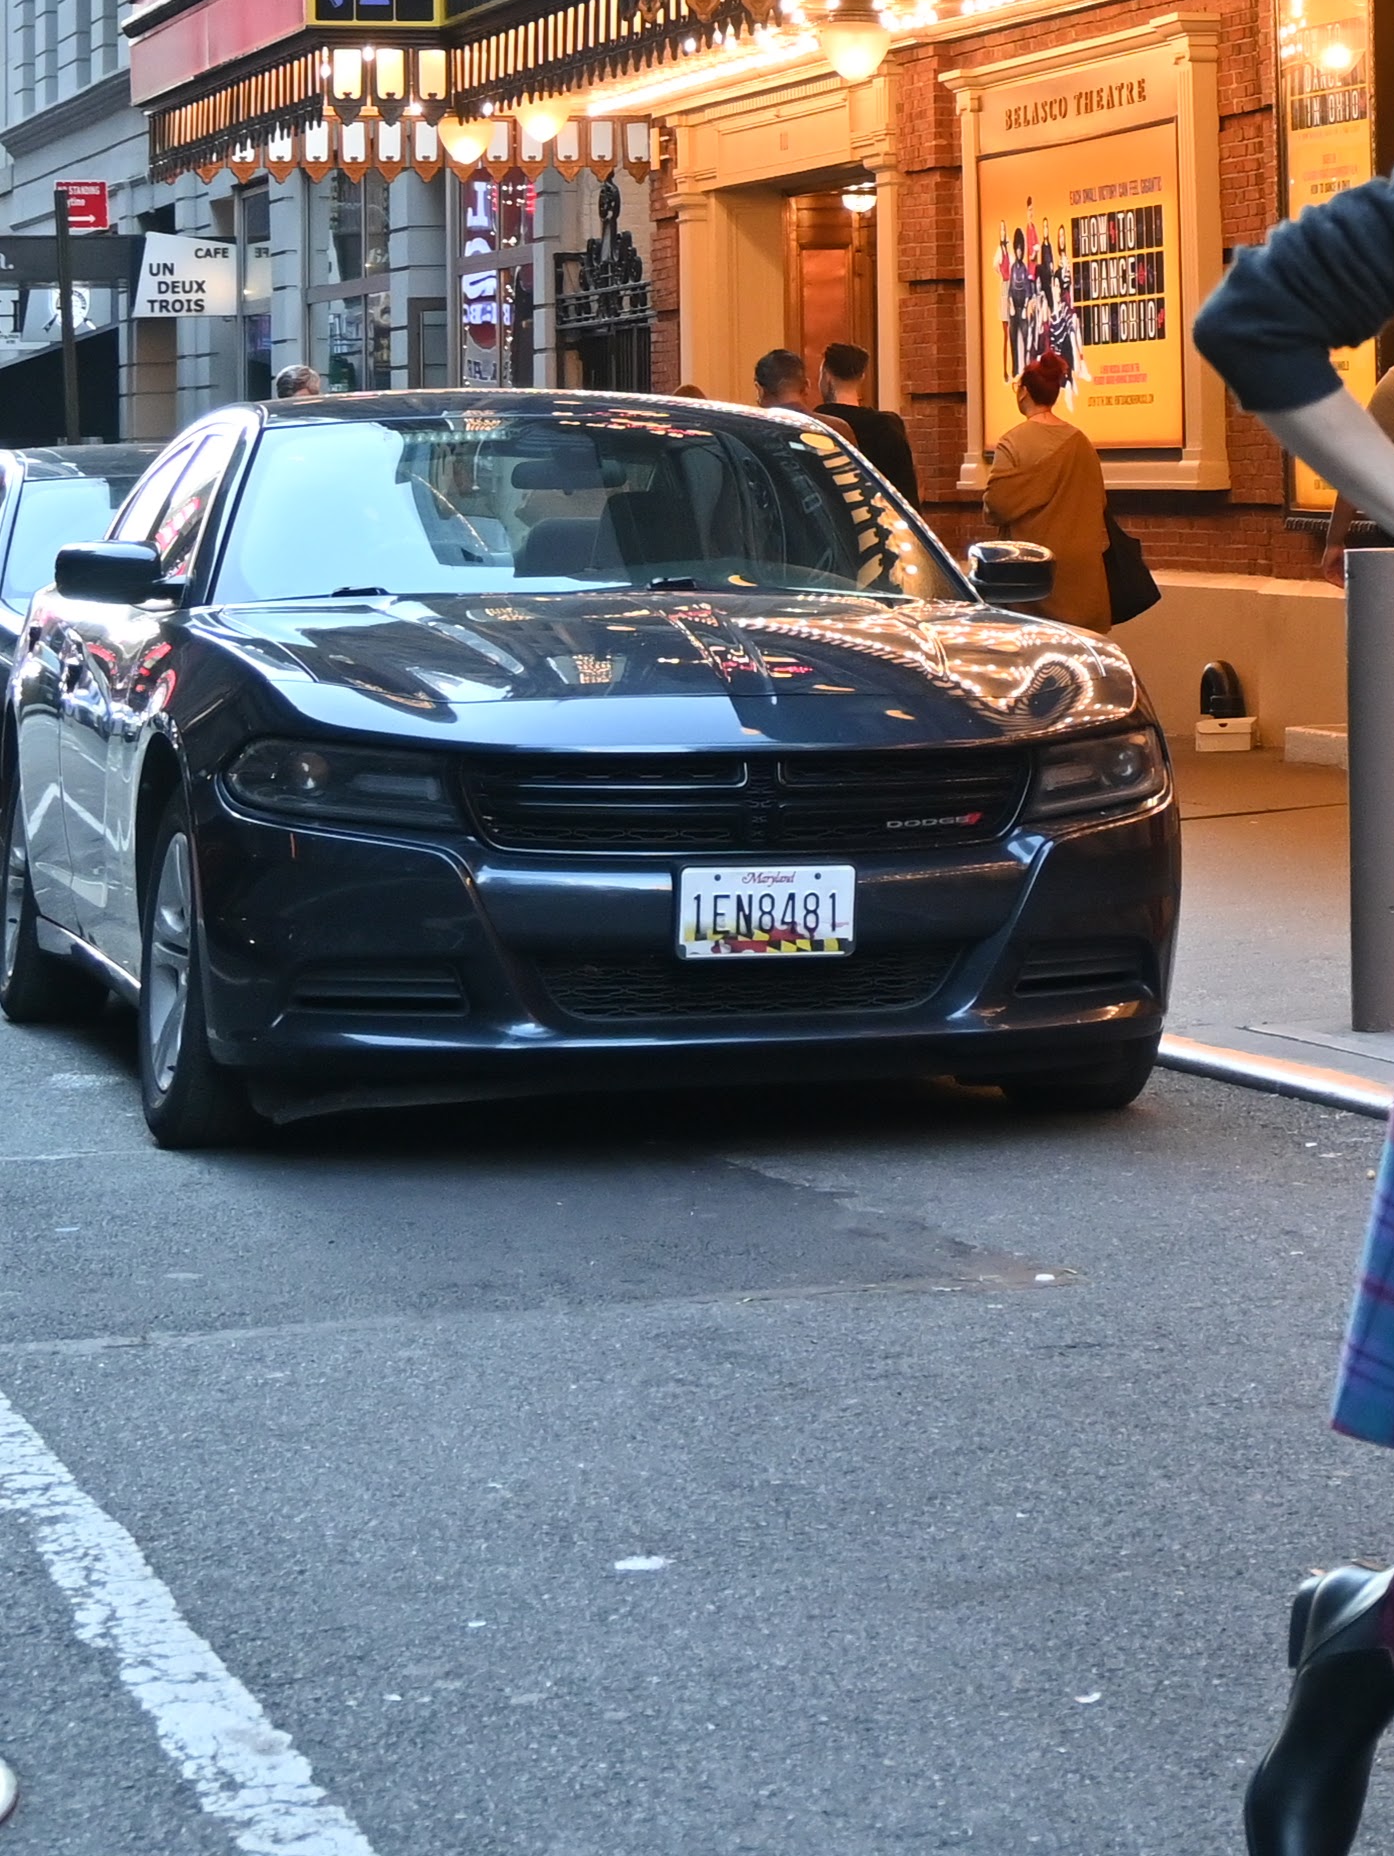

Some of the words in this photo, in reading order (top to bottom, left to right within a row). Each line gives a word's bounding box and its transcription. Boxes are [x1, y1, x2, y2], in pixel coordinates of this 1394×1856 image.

[1005, 96, 1068, 131] BELASCO
[1074, 78, 1146, 116] THEATRE
[1307, 97, 1320, 127] IN
[1328, 89, 1359, 123] OHIO
[1080, 215, 1107, 255] HOW
[1117, 211, 1135, 250] TO
[194, 247, 230, 259] CAFE
[149, 262, 175, 276] UN
[1091, 257, 1136, 299] DANCE
[157, 280, 206, 295] DEUX
[147, 299, 205, 314] TROIS
[1094, 305, 1109, 343] IN
[1120, 300, 1156, 341] OHIO
[886, 815, 970, 829] DODGE
[742, 871, 797, 887] Maryland
[693, 892, 837, 938] 1EN8481
